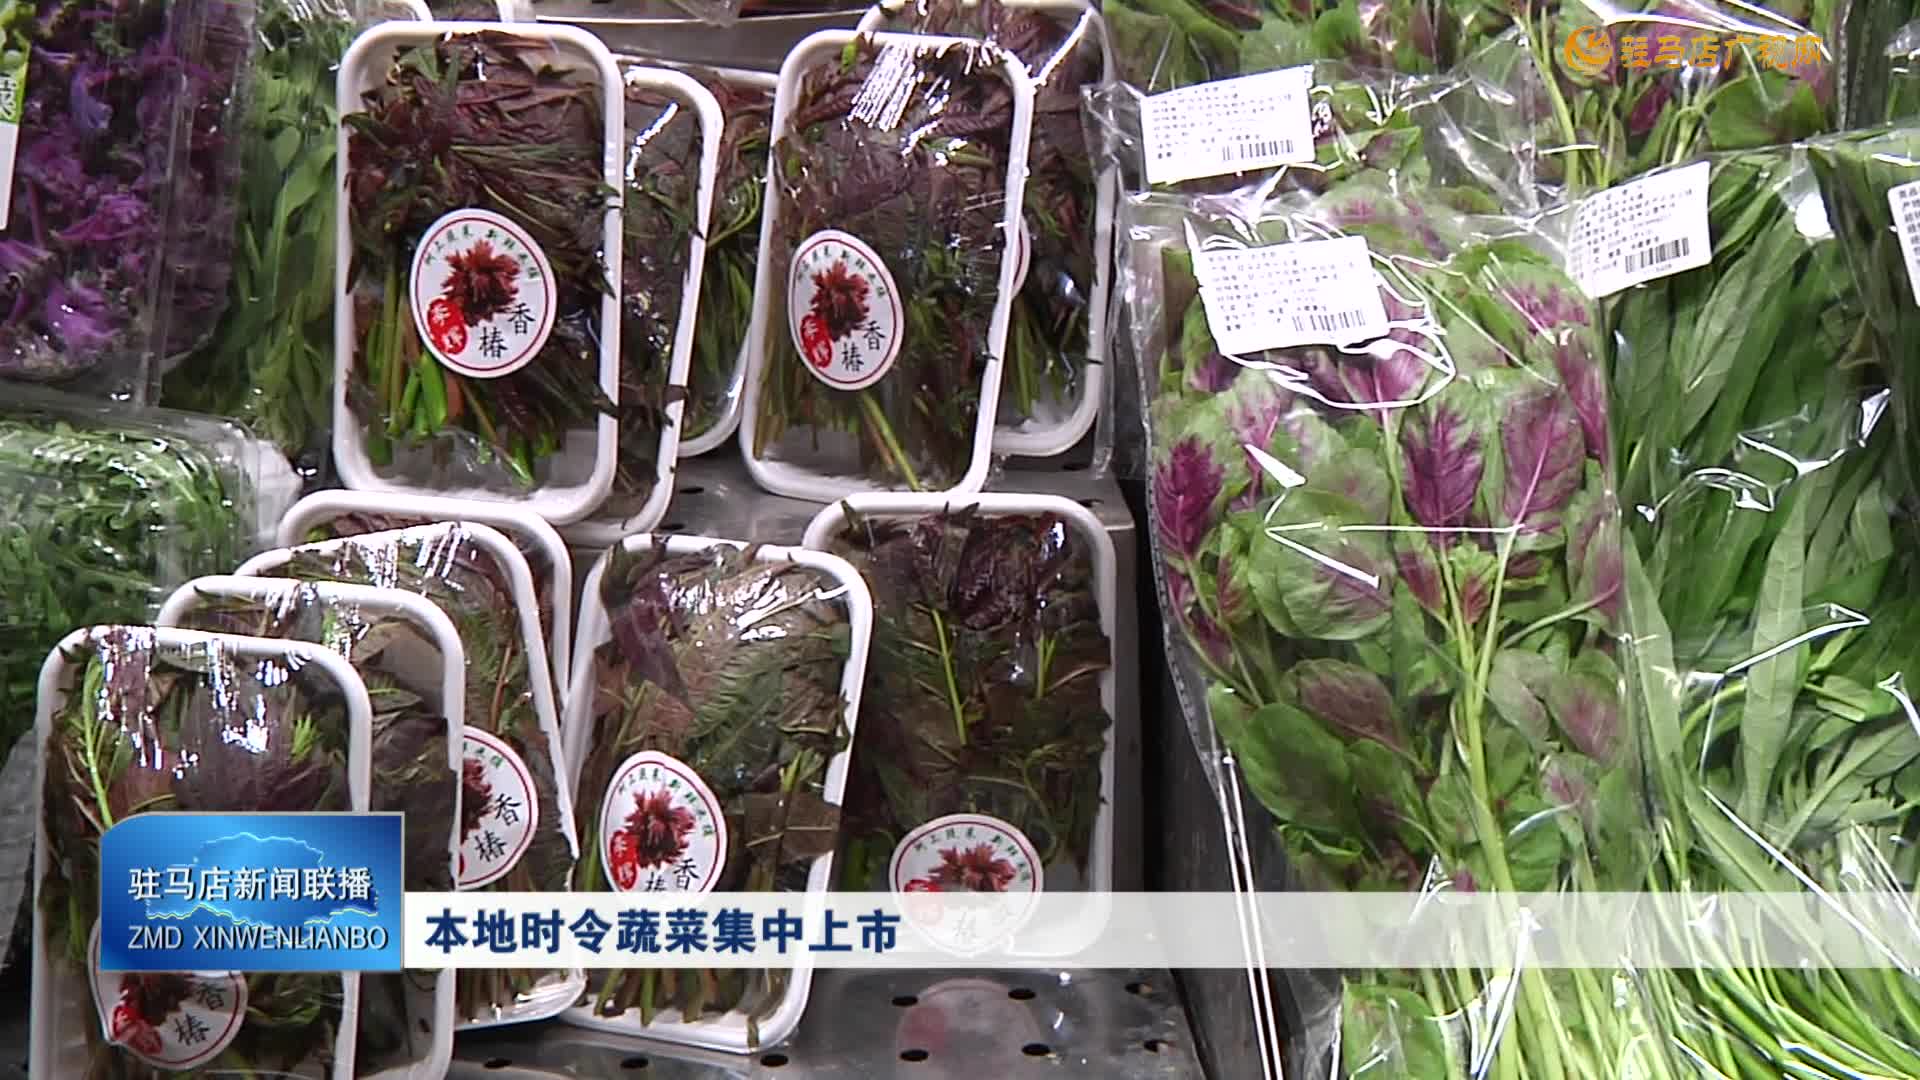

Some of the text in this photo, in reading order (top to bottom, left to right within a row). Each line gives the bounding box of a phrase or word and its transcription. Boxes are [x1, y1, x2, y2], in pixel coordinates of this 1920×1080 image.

[478, 302, 537, 359] 香椿
[840, 319, 886, 373] 香椿
[474, 793, 522, 863] 香椿
